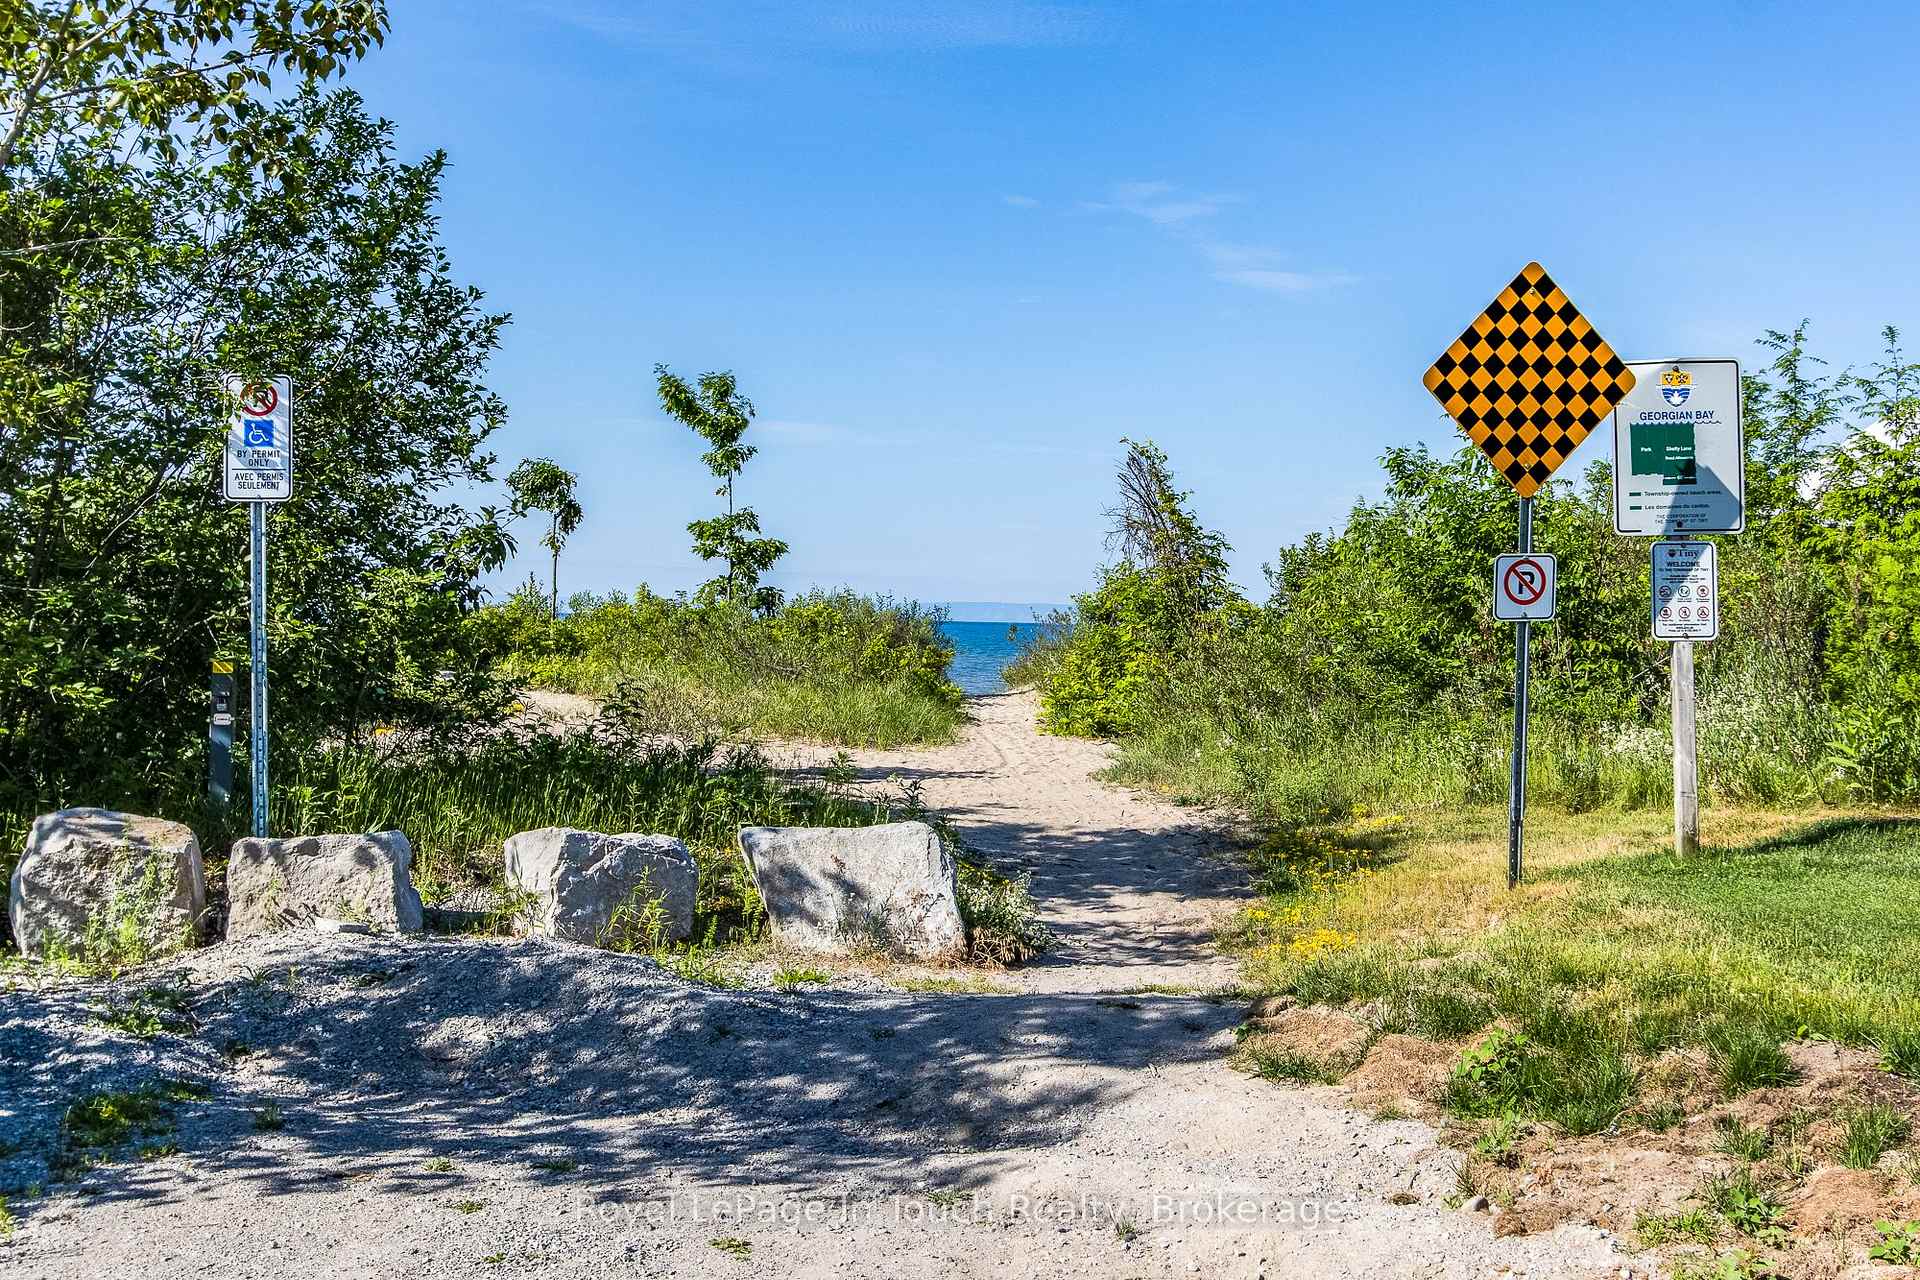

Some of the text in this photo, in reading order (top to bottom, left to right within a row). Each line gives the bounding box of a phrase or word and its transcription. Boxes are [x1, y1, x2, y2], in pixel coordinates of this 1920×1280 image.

[1640, 410, 1714, 421] GEORGIAN BAY
[237, 450, 280, 458] BY PERMIT
[248, 458, 270, 467] ONLY
[234, 473, 284, 482] AVEC PERMIS
[238, 481, 280, 490] SEULEMENT
